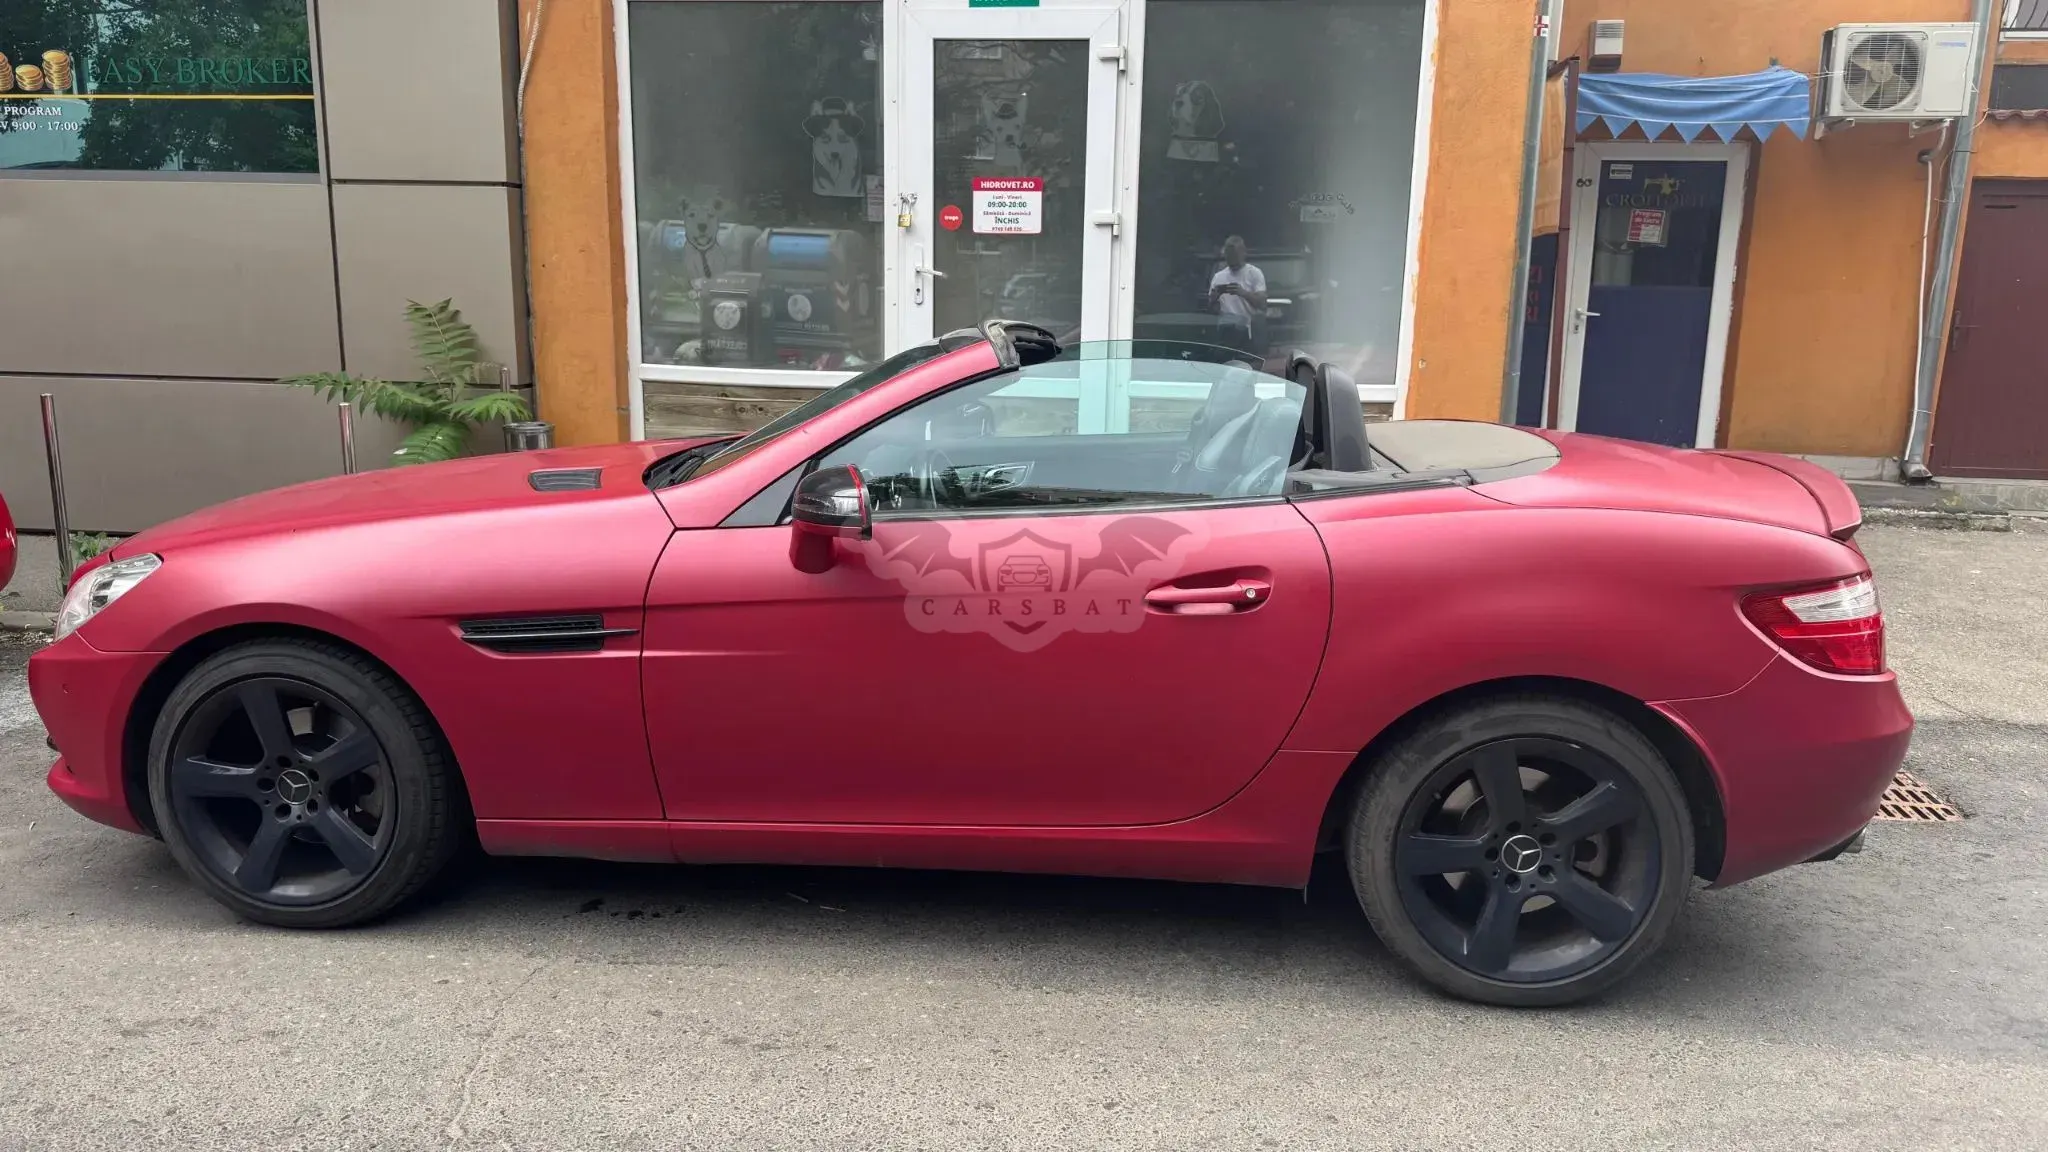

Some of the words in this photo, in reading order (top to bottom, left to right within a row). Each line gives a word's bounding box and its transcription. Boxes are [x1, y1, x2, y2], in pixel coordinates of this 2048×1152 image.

[87, 57, 167, 84] EASY
[177, 57, 313, 84] BROKER
[4, 106, 62, 116] PROGRAM
[11, 121, 37, 131] 9:00
[47, 121, 79, 131] 17:00
[980, 180, 1035, 189] HIDROVET.RO
[994, 216, 1019, 224] ÎNCHIS
